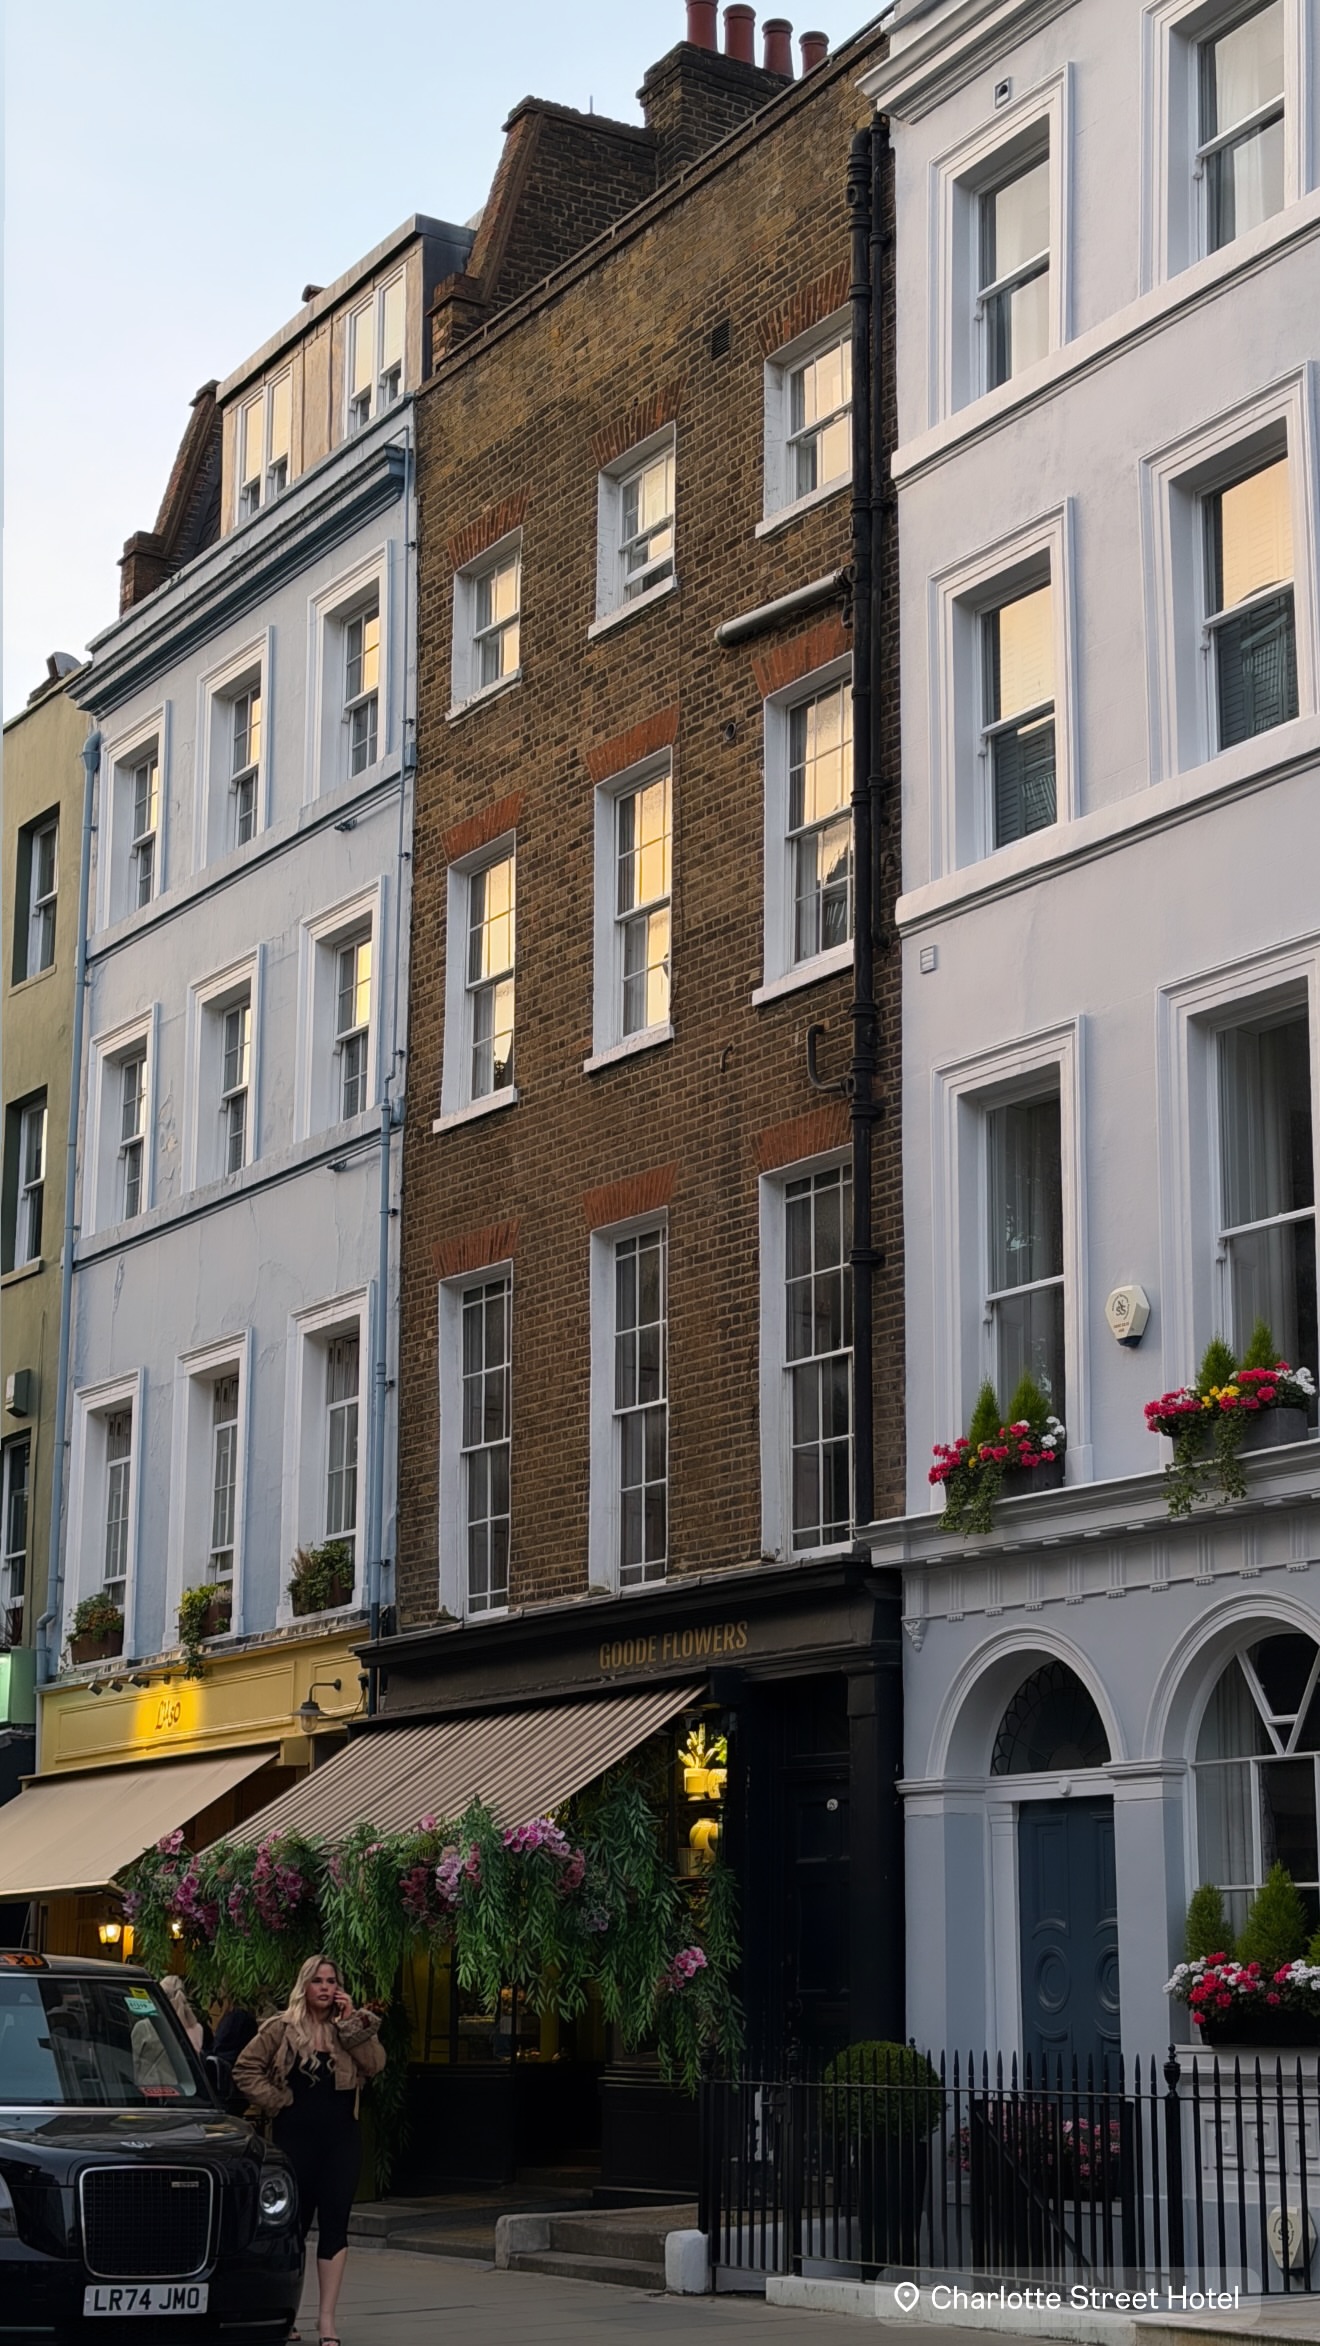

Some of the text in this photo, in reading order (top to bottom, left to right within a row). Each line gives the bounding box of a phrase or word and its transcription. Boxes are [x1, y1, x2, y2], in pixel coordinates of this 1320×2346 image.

[599, 1620, 749, 1670] GOODE FLOWERS
[93, 2286, 201, 2312] LR74 JMO
